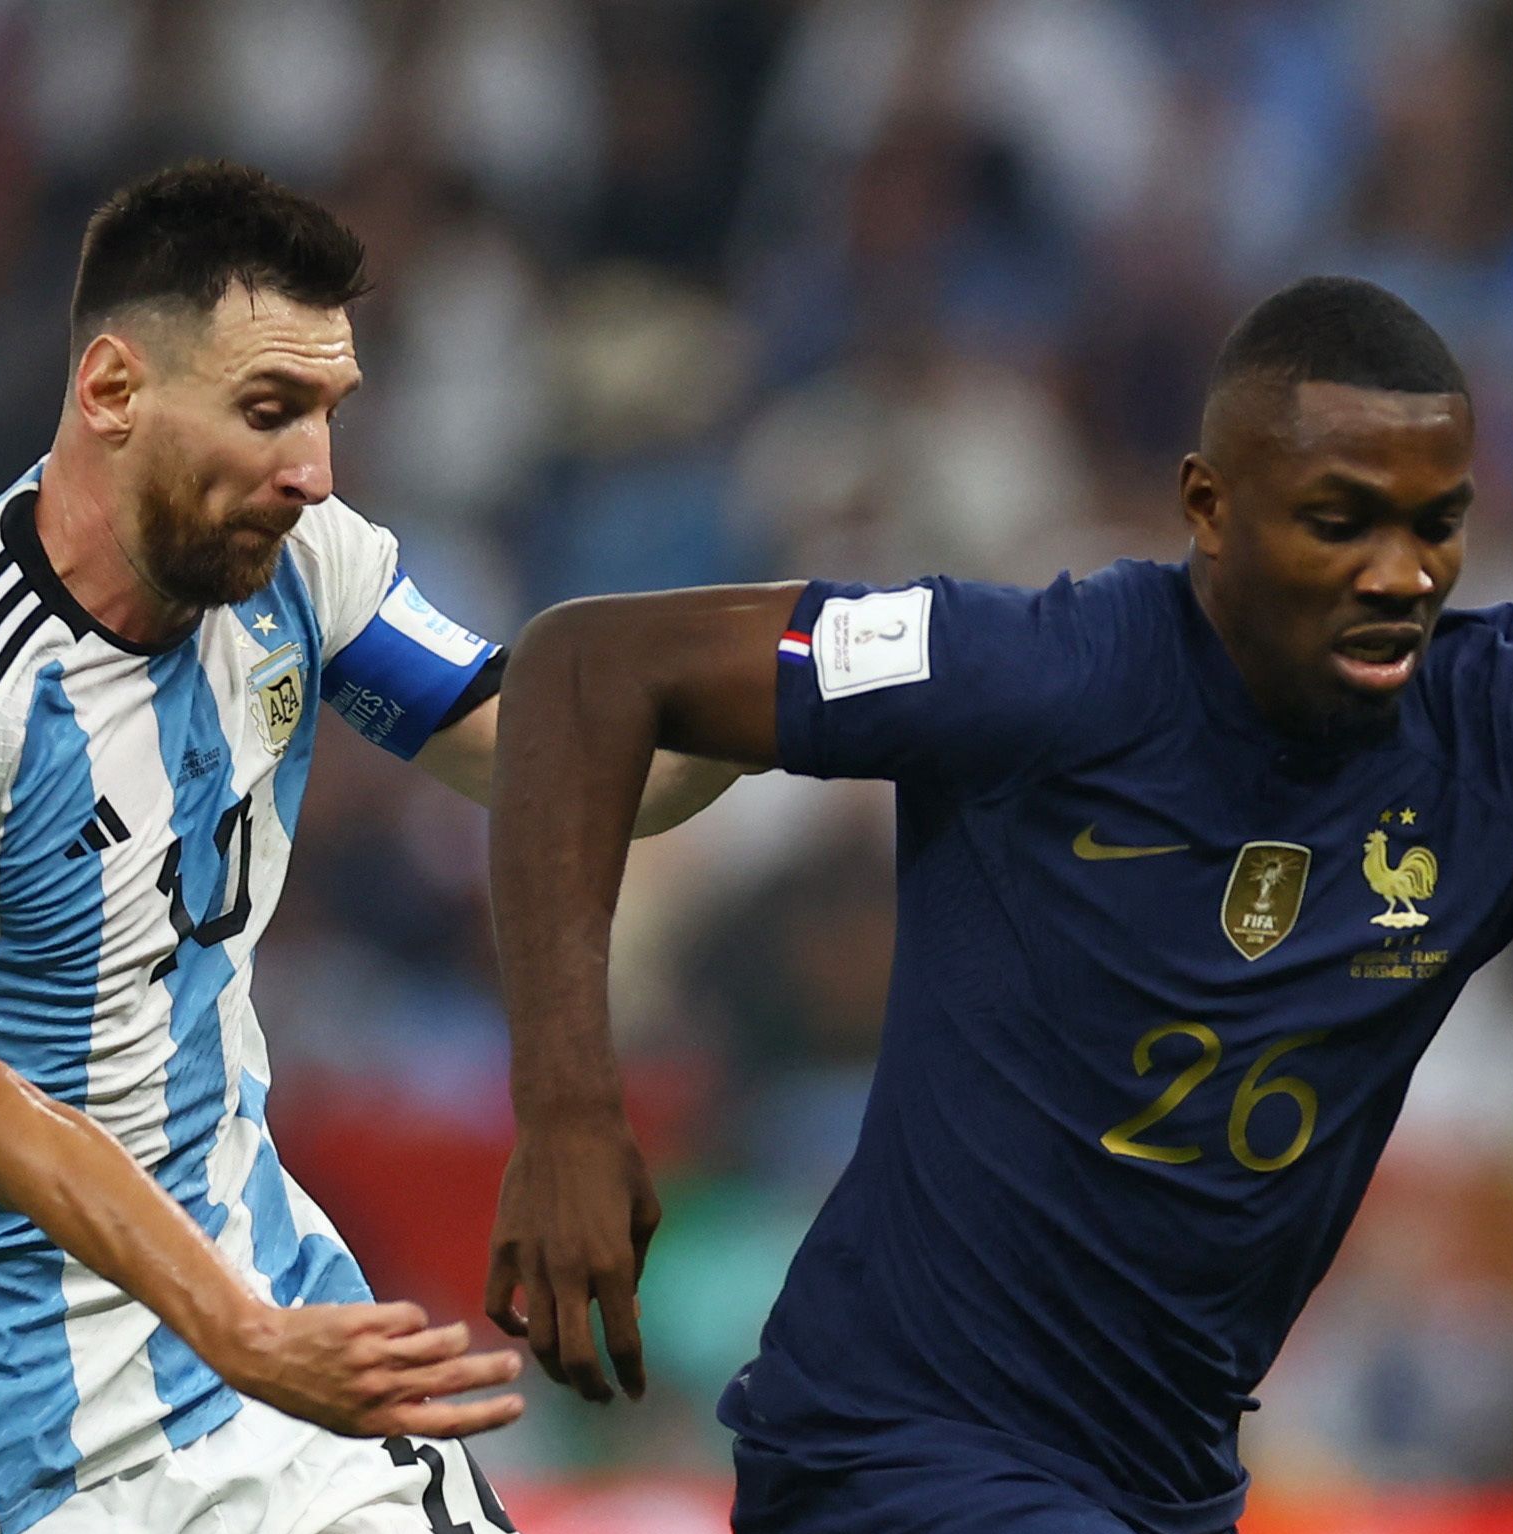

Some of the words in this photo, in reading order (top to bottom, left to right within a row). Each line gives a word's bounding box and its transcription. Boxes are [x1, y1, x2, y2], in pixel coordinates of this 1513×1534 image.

[267, 675, 299, 726] AFA
[148, 791, 253, 986] 10
[1242, 913, 1274, 929] FIFA
[1099, 1020, 1333, 1173] 26
